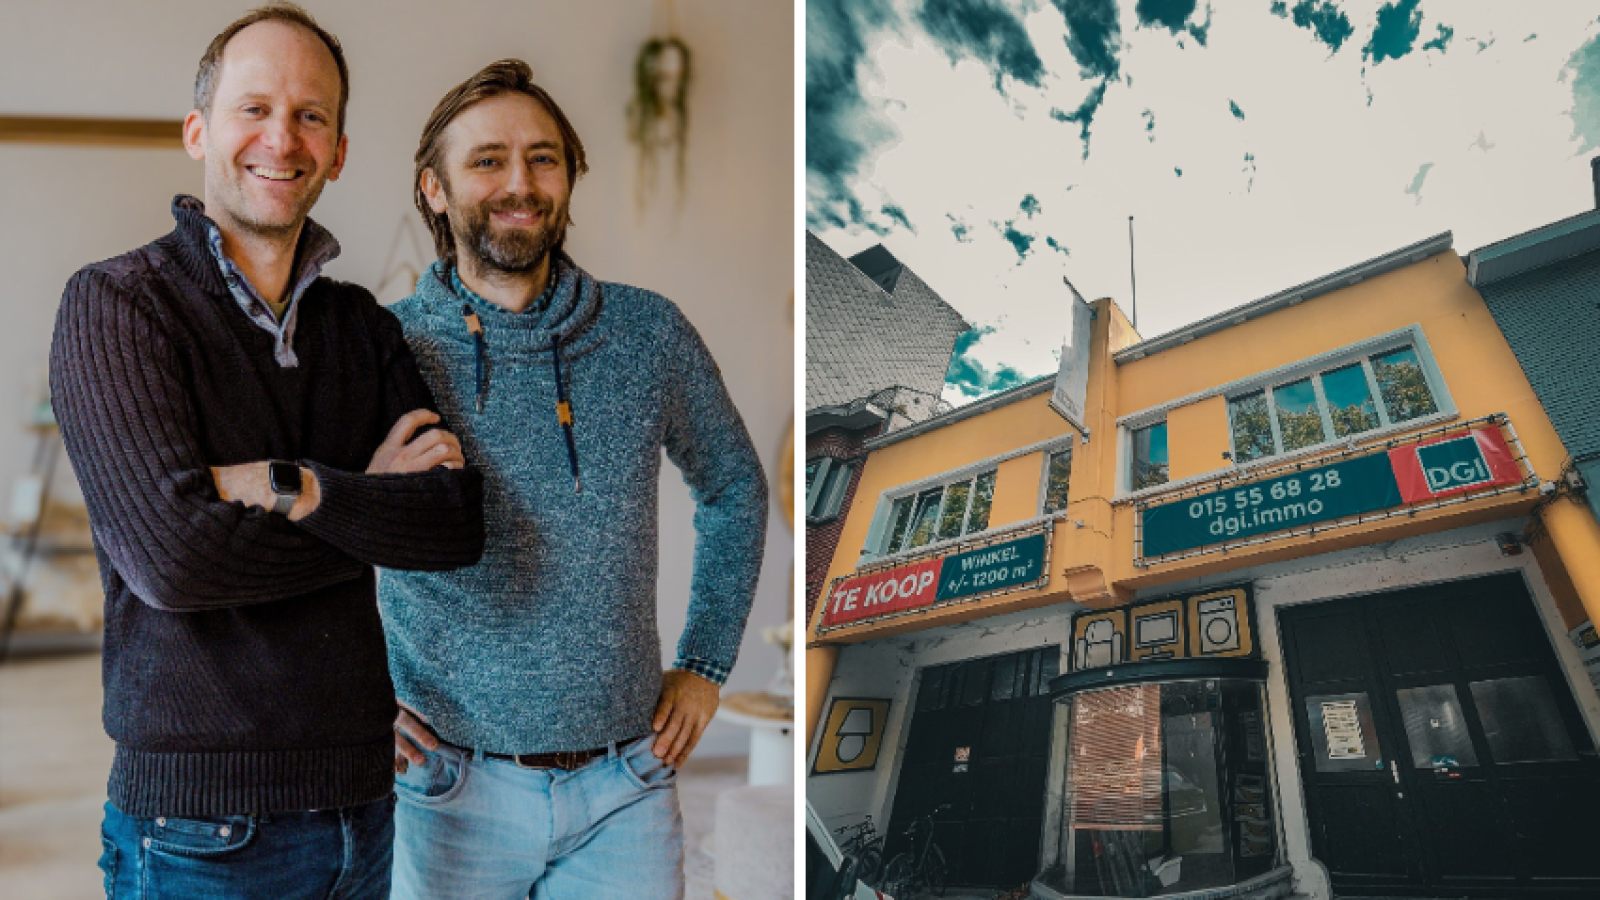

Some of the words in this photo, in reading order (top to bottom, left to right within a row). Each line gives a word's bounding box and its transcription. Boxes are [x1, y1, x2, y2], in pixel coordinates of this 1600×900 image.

[1189, 497, 1227, 519] 015
[1234, 487, 1264, 511] 55
[1270, 478, 1302, 501] 68
[1309, 469, 1341, 491] 28
[1209, 498, 1324, 537] dgi.immo
[961, 546, 1021, 571] WINKEL
[973, 566, 1010, 588] 1200
[832, 588, 861, 615] TE
[864, 570, 936, 607] KOOP
